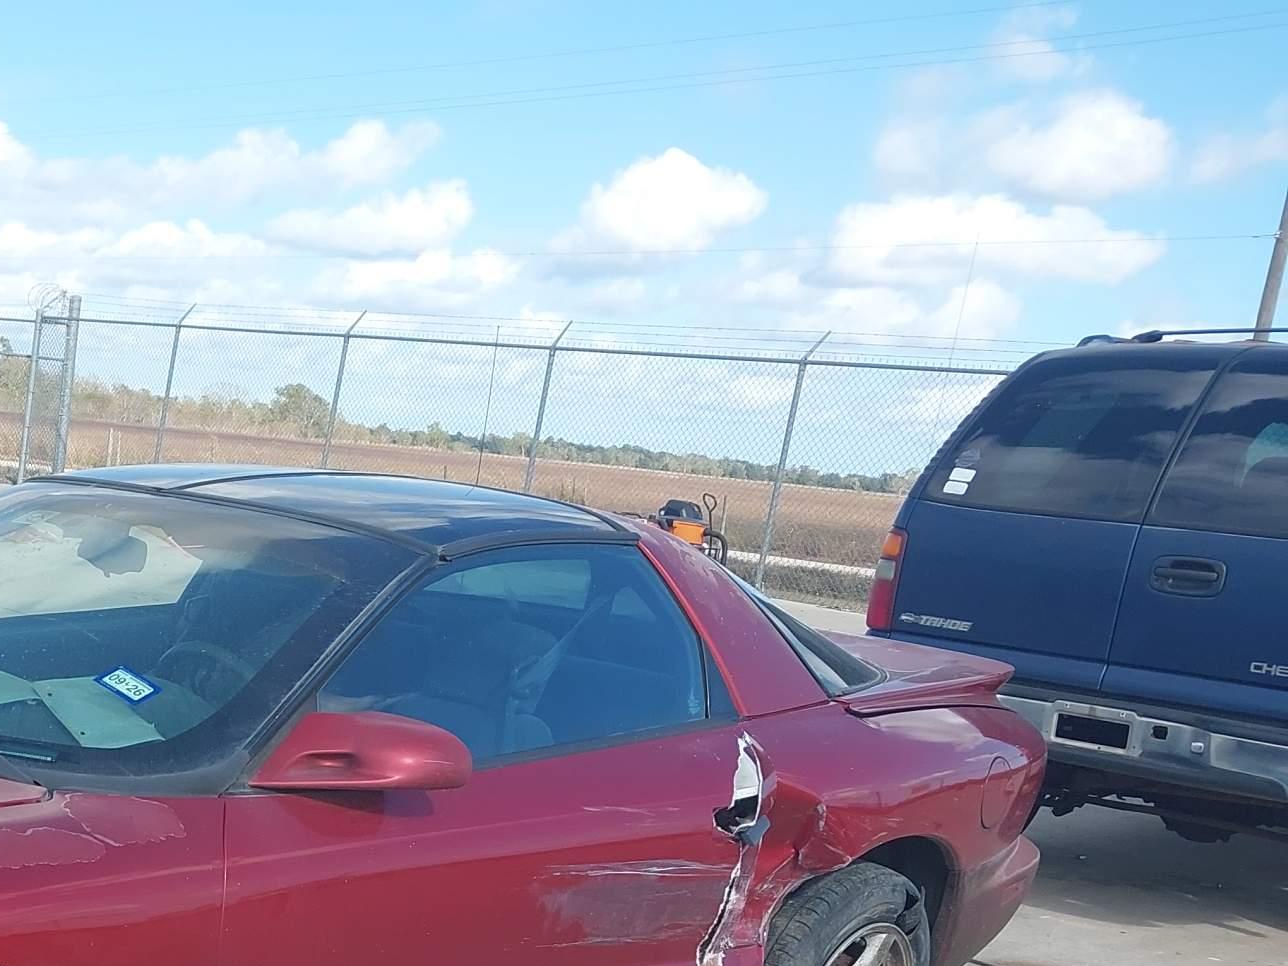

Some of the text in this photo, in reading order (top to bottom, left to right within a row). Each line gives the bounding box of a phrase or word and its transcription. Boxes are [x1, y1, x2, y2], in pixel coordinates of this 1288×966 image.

[919, 615, 974, 631] TAHOE
[108, 673, 127, 685] 09
[126, 684, 146, 697] 26
